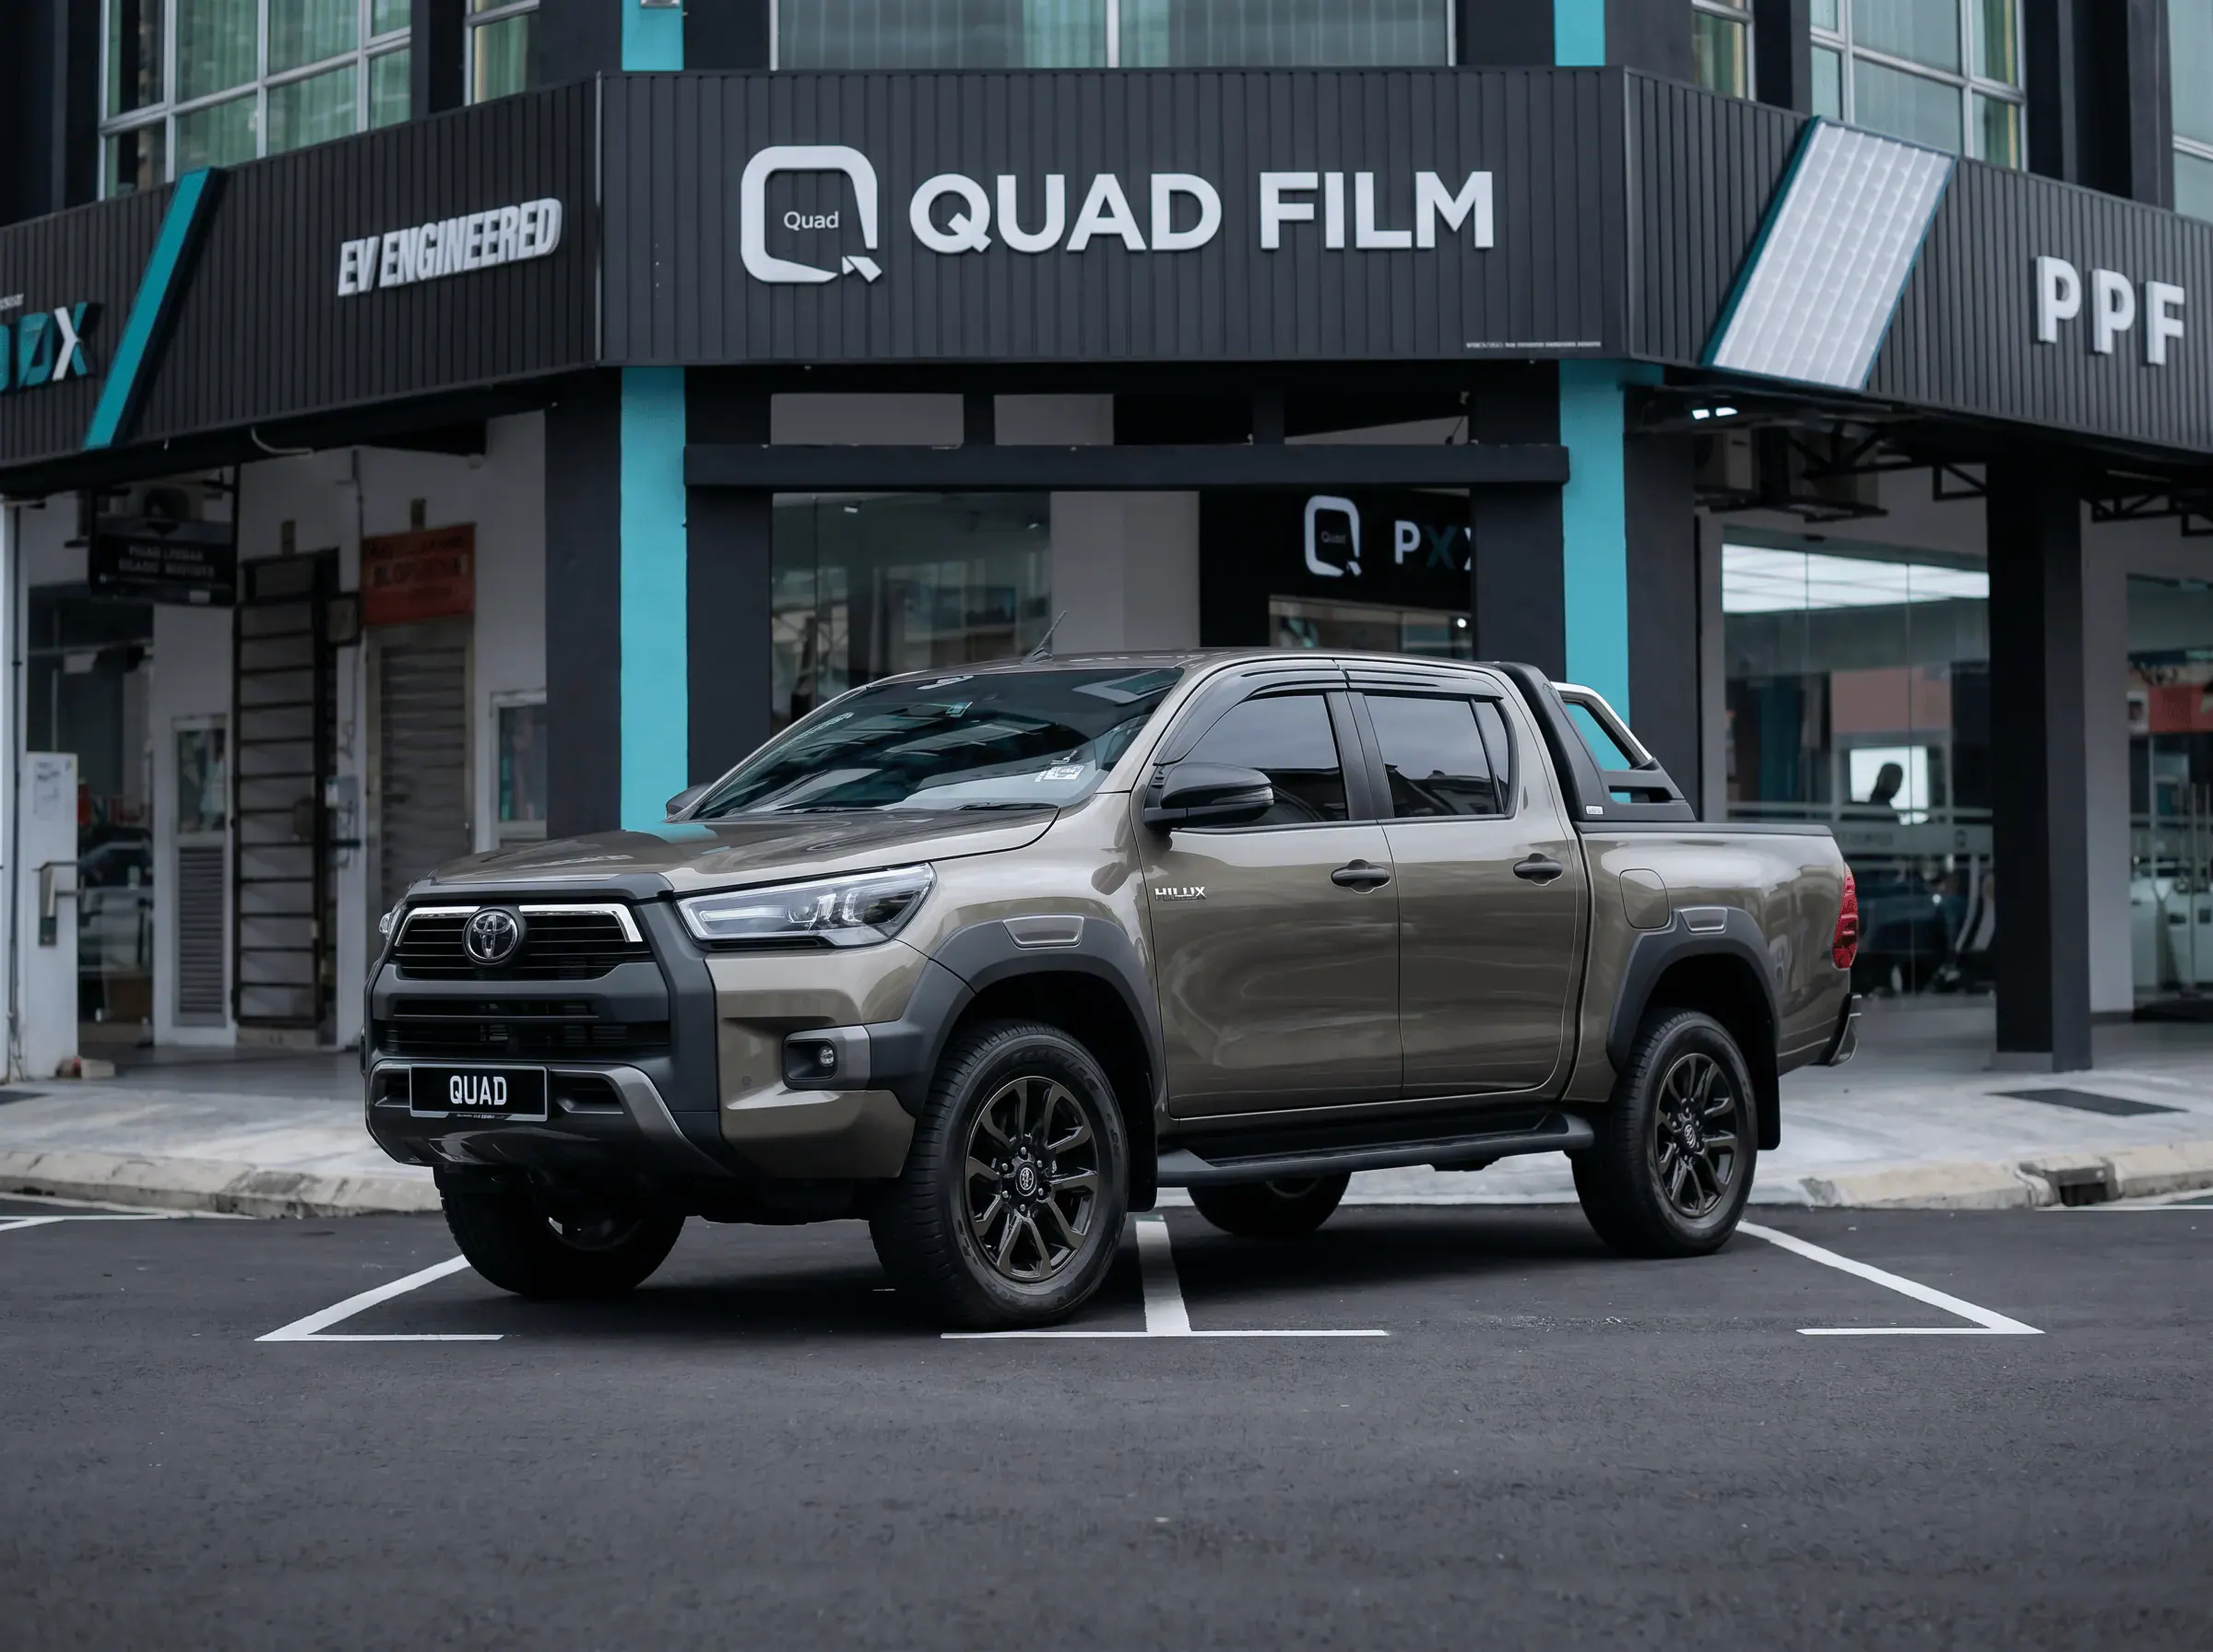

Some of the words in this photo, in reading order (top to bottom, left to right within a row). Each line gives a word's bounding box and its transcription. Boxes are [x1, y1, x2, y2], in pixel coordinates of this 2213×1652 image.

[783, 210, 839, 231] Quad
[909, 172, 1222, 254] QUAD
[1260, 171, 1495, 250] FILM
[337, 236, 380, 297] EV
[379, 197, 562, 288] ENGINEERED
[2036, 254, 2185, 366] PPF
[1154, 886, 1207, 900] HILUX
[449, 1075, 507, 1105] QUAD
